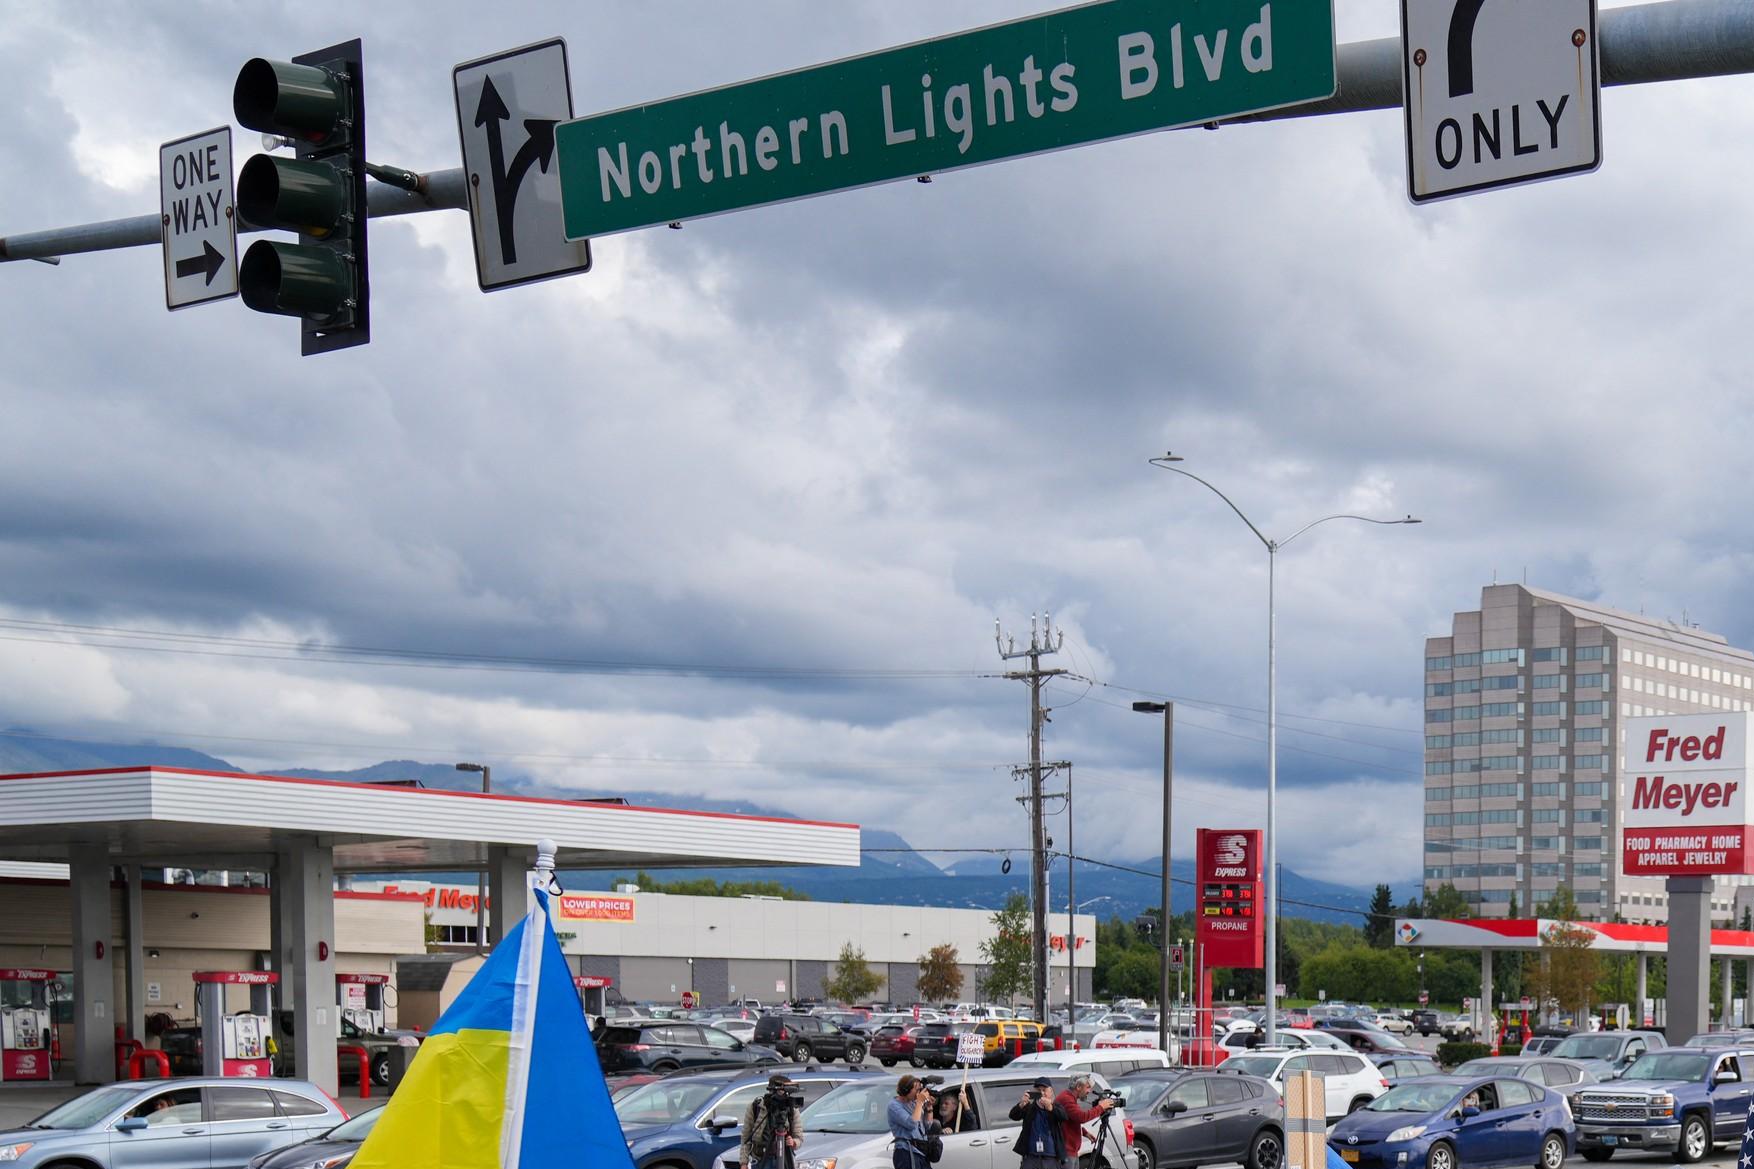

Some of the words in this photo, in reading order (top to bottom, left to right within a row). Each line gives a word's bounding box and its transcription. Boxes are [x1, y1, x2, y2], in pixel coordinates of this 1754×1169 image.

[598, 109, 849, 203] Northern
[882, 55, 1080, 155] Lights
[1118, 3, 1273, 101] Blvd
[1435, 94, 1570, 170] ONLY
[173, 145, 221, 190] ONE
[173, 187, 224, 235] WAY
[1646, 726, 1726, 762] Fred
[1632, 776, 1738, 816] Meyer
[1626, 838, 1650, 850] FOOD
[1655, 836, 1707, 850] PHARMACY
[1712, 835, 1741, 849] HOME
[1638, 852, 1679, 866] APPAREL
[1683, 852, 1727, 865] JEWELRY
[1215, 867, 1247, 877] EXPRESS
[564, 899, 596, 909] LOWER
[599, 901, 631, 910] PRICES
[1211, 921, 1248, 931] PROPANE
[237, 972, 269, 983] EXPRESS
